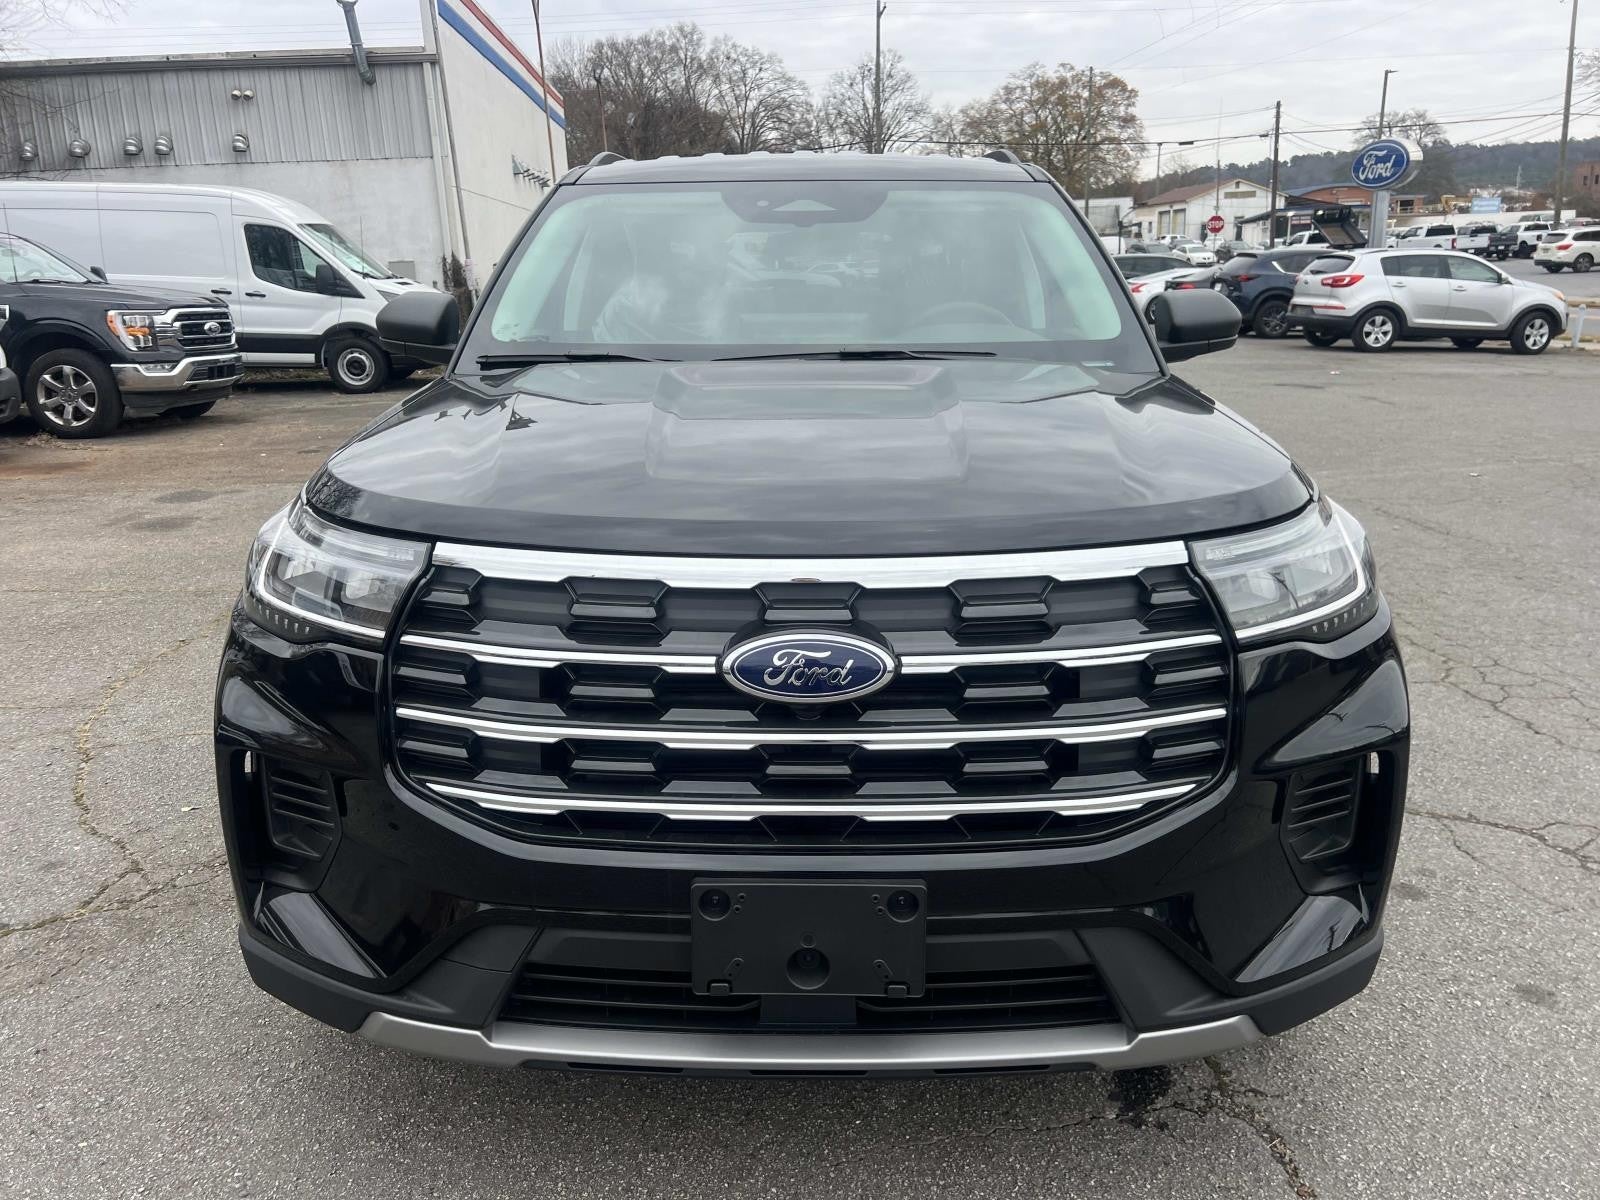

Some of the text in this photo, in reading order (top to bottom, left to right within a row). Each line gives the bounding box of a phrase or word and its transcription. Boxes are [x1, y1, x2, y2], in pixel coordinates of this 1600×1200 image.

[1359, 150, 1396, 180] Ford
[1207, 220, 1224, 229] STOP
[764, 649, 855, 686] Ford
